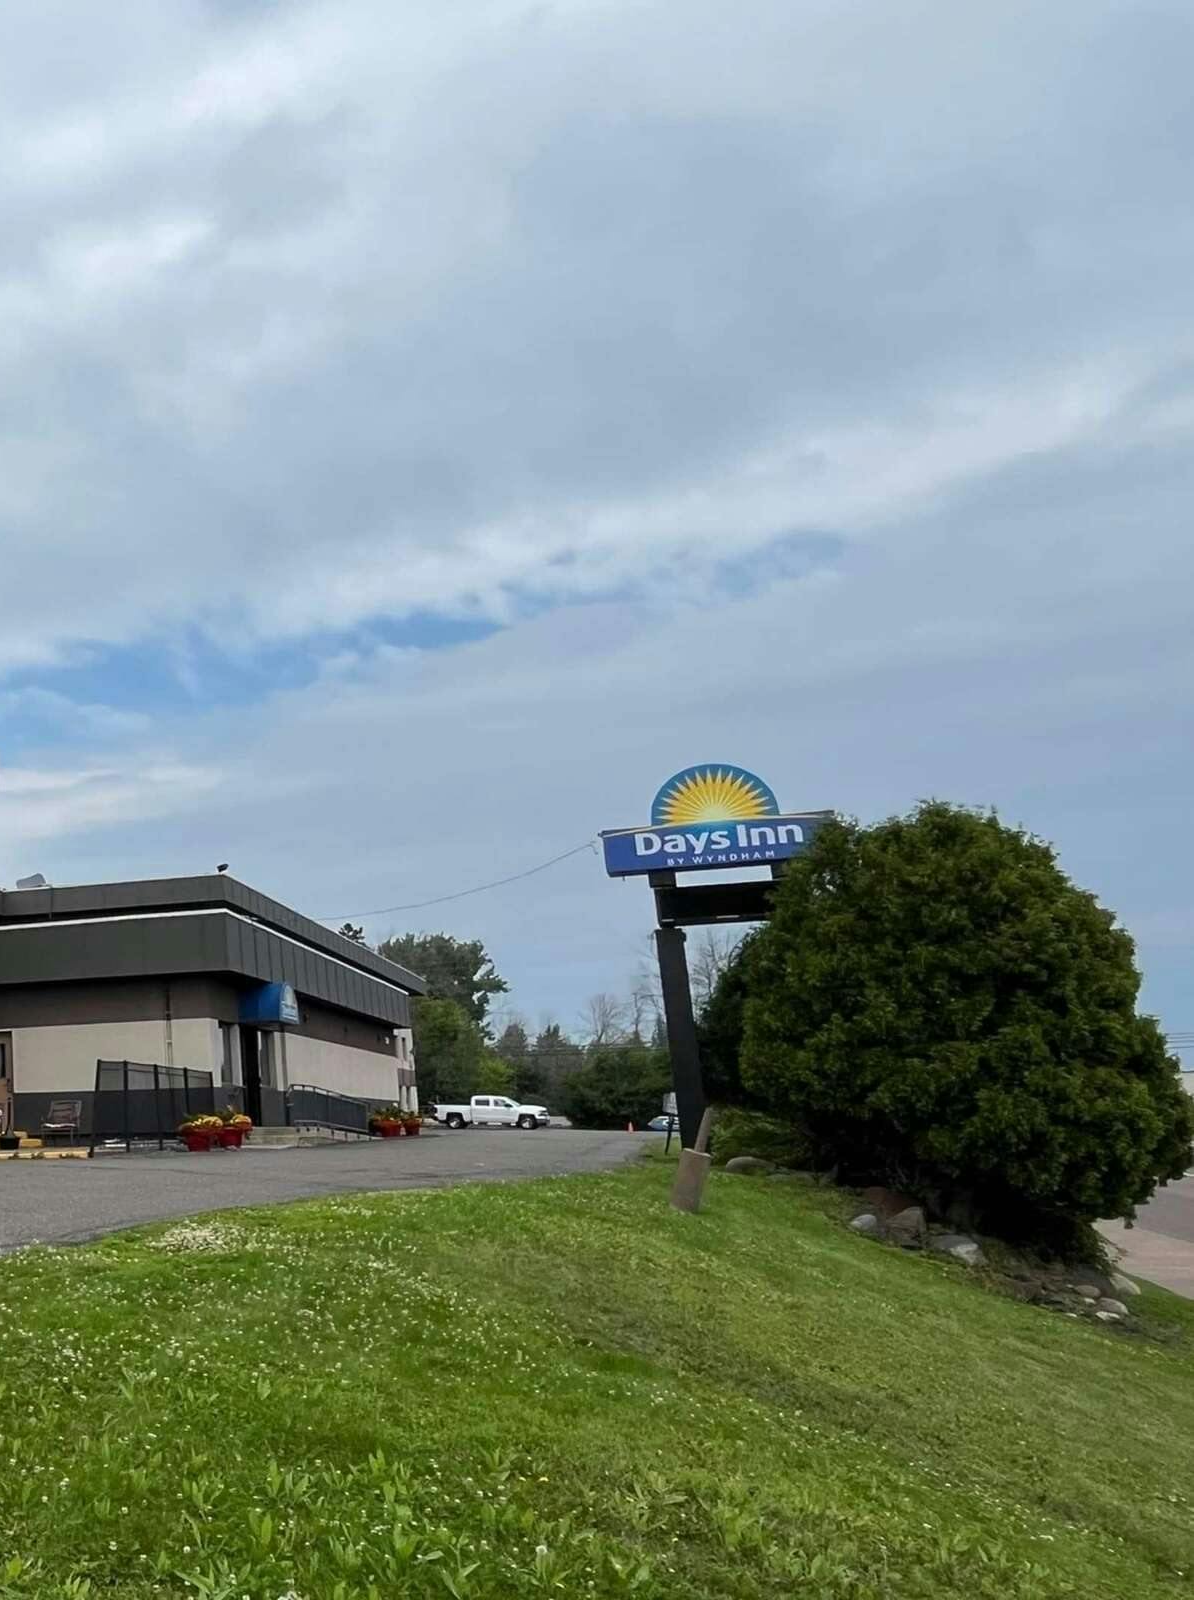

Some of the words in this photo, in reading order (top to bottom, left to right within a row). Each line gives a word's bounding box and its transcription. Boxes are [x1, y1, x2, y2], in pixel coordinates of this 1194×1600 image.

[634, 830, 730, 856] Days
[736, 824, 804, 847] Inn
[667, 857, 684, 866] BY
[692, 850, 775, 864] WYNDHAM
